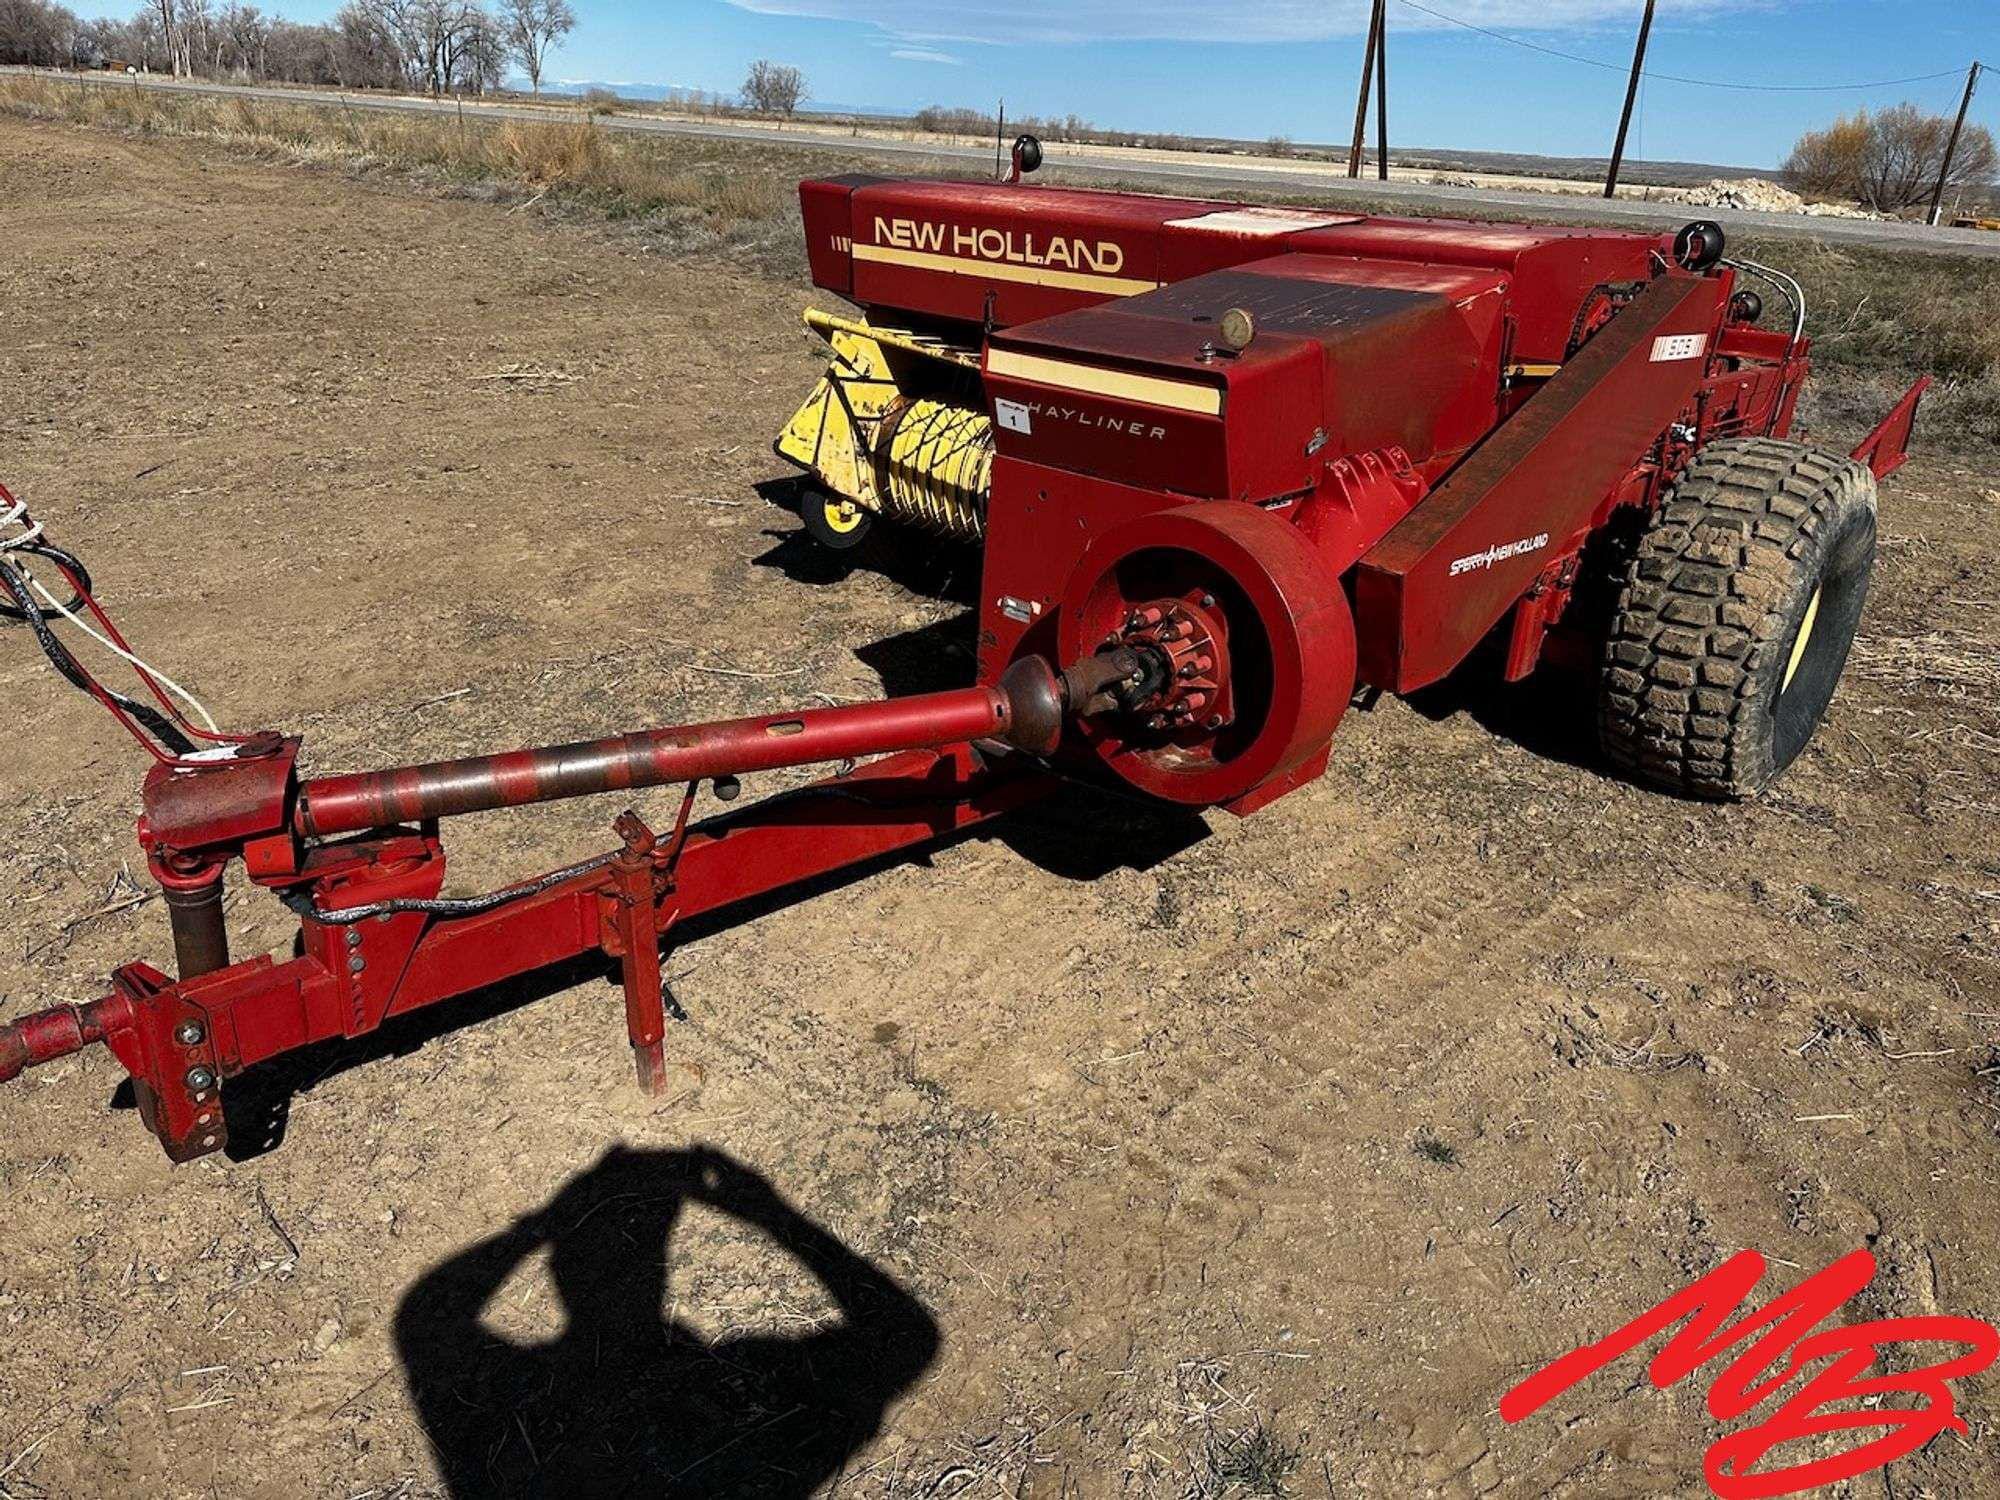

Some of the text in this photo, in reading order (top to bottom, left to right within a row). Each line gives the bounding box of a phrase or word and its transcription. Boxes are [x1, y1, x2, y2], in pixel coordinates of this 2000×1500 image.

[874, 216, 1123, 273] NEW HOLLAND
[1668, 338, 1693, 356] 505
[1010, 415, 1017, 427] 1
[1028, 401, 1166, 440] HAYLINER
[1449, 552, 1487, 577] SPERRY
